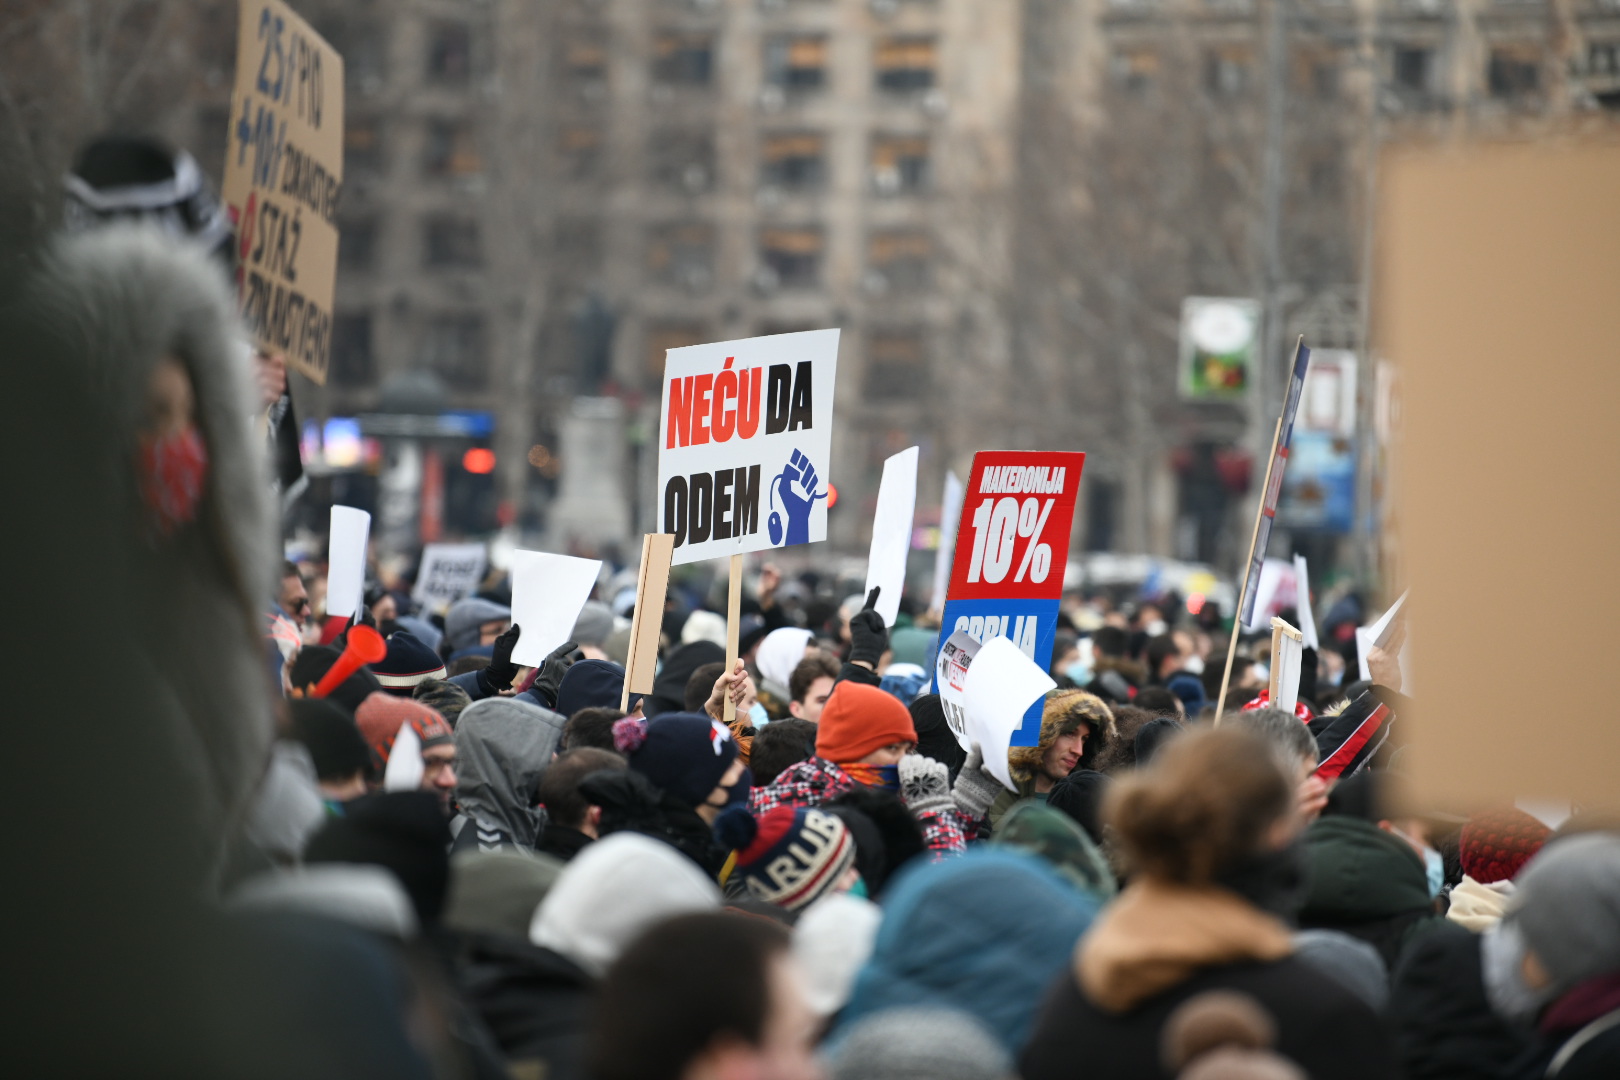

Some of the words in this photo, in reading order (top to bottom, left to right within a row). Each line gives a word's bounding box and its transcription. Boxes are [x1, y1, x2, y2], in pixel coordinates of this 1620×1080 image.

[666, 357, 762, 449] NEĆU
[766, 361, 812, 435] DA
[664, 464, 761, 548] ODEM
[979, 466, 1066, 494] MAKEDONIJA
[967, 497, 1055, 583] 10%
